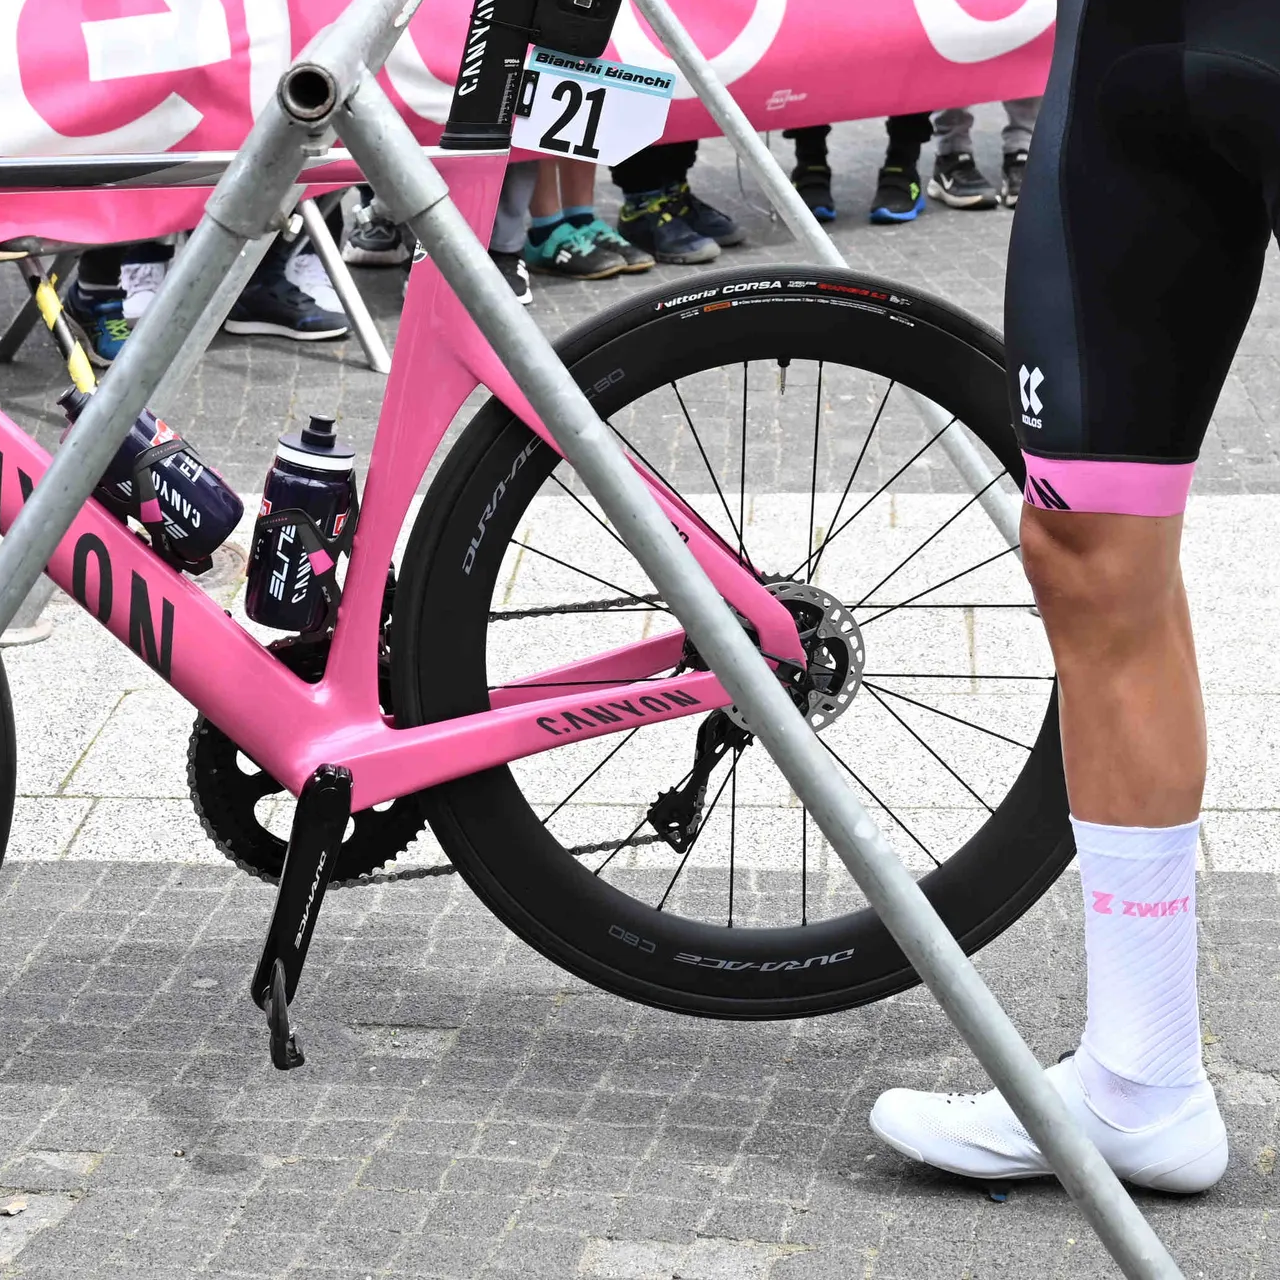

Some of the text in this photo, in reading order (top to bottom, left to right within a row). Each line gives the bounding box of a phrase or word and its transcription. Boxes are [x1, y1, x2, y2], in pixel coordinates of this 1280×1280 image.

[535, 51, 672, 90] Bianchi Bianchi
[538, 80, 607, 159] 21
[663, 288, 716, 308] vittoria
[722, 280, 783, 294] CORSA
[151, 470, 201, 529] CANYO
[536, 688, 702, 737] CANYON
[294, 850, 327, 951] DURA-ACE
[1122, 895, 1191, 919] ZWIFT
[672, 947, 856, 974] DURA-ACE
